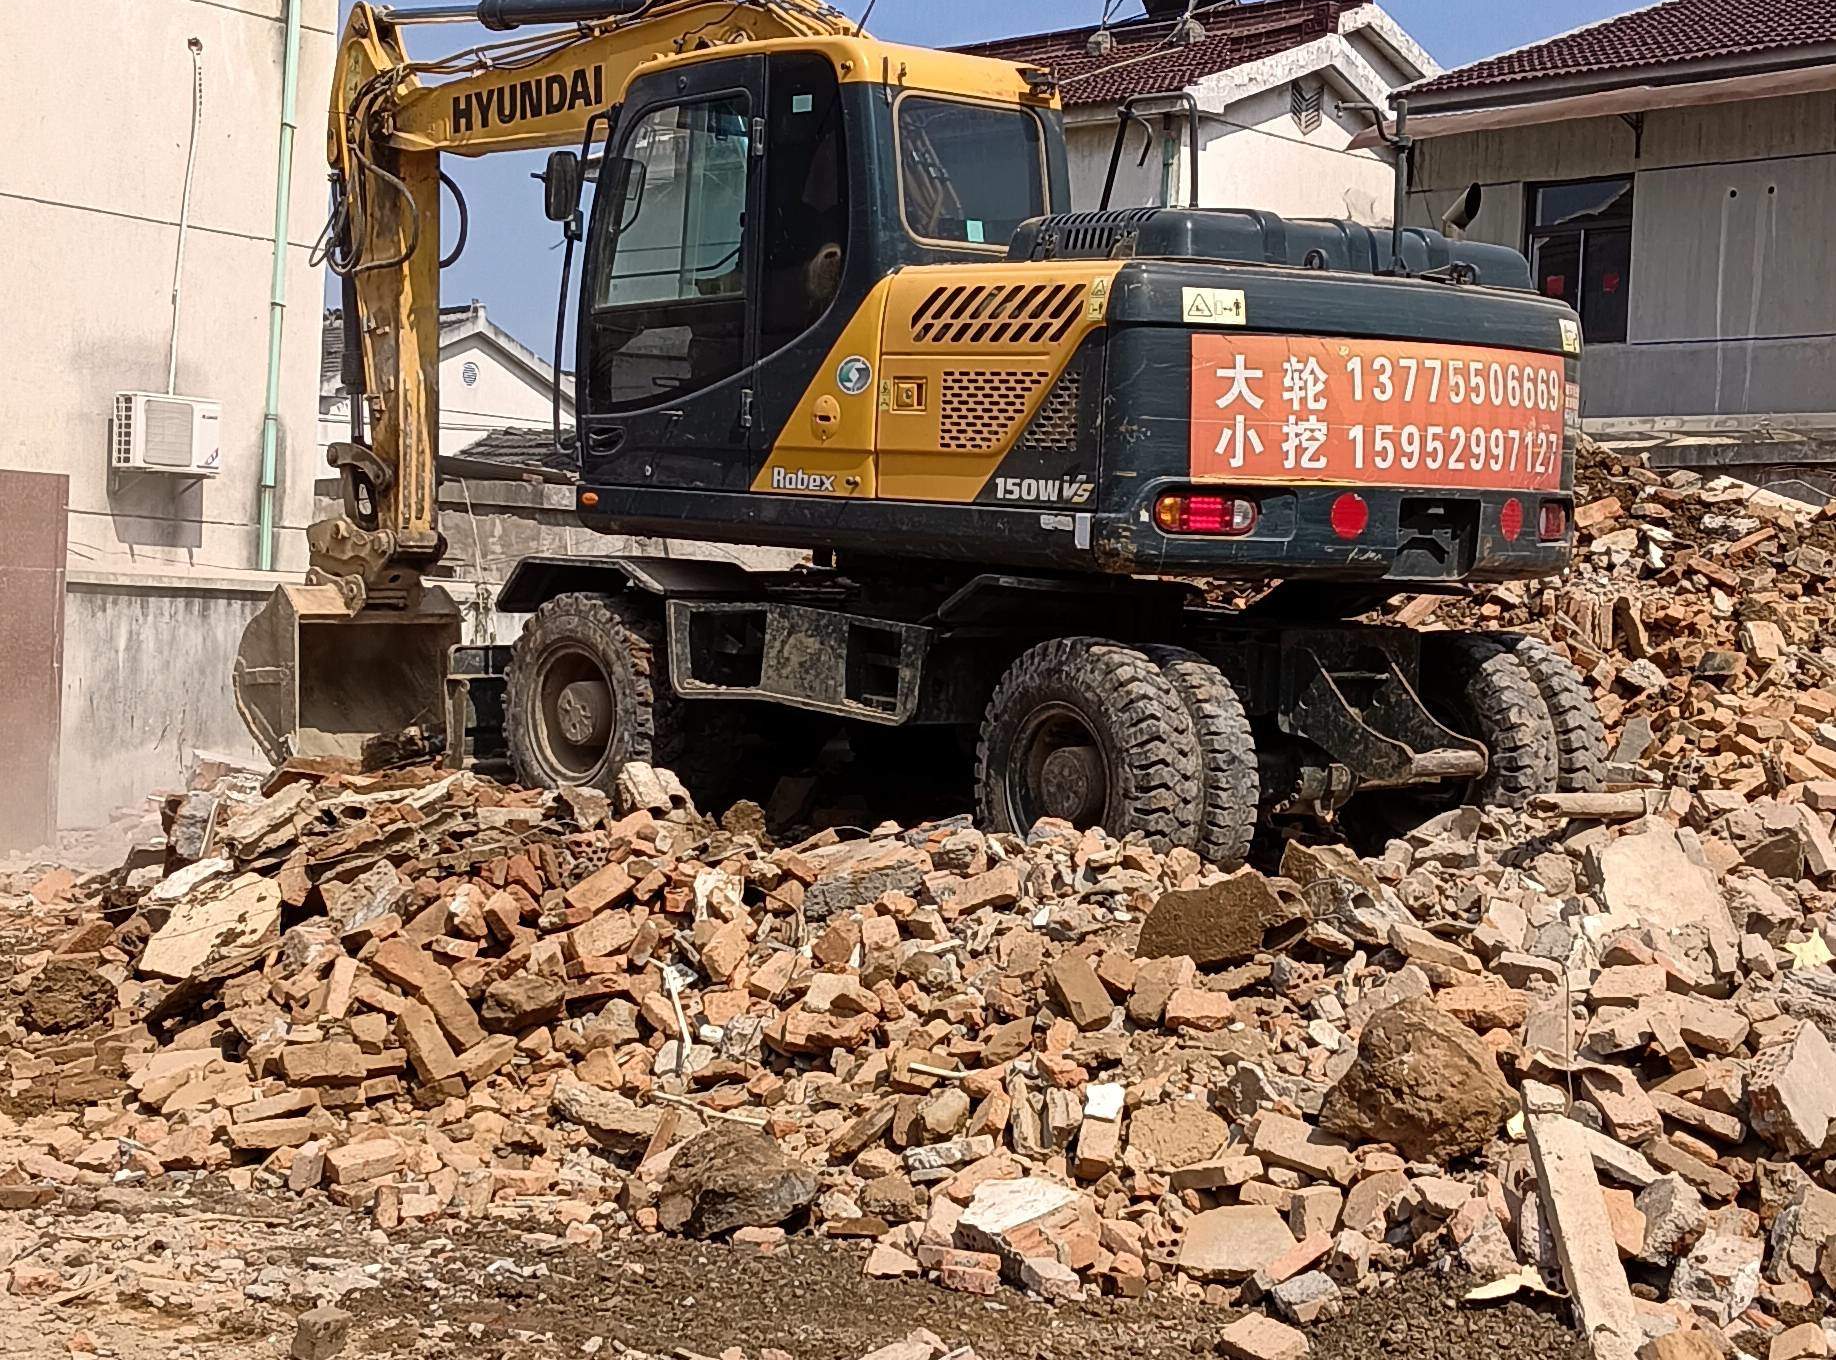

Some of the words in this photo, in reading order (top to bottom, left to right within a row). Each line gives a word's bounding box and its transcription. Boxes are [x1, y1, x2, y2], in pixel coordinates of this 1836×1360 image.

[452, 65, 603, 133] HYUNDAI
[1346, 356, 1558, 411] 13775506669
[1348, 425, 1557, 474] 15952997127
[773, 467, 835, 491] Robex
